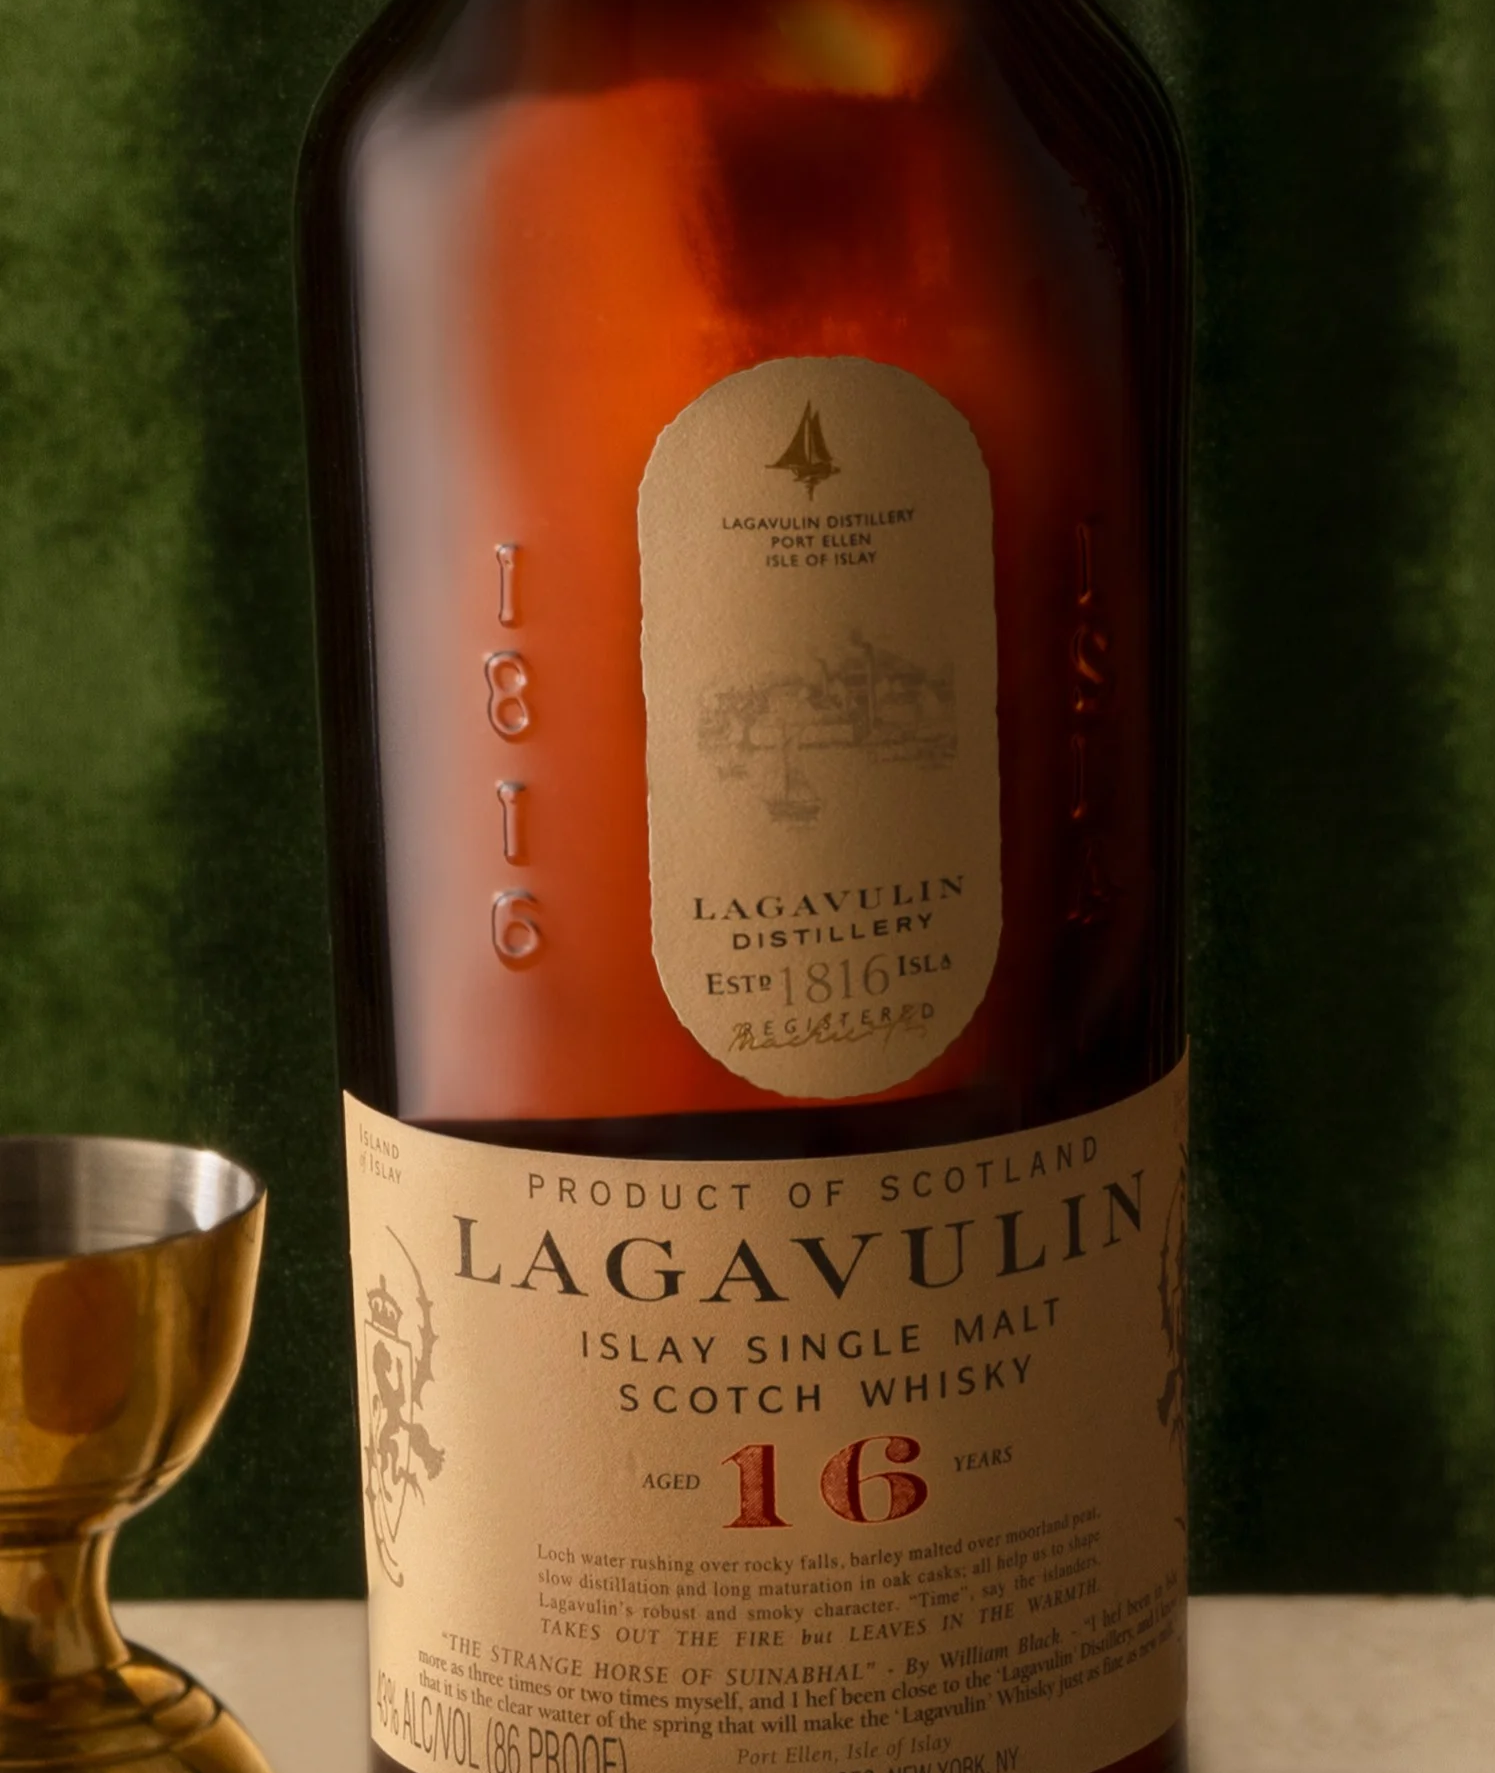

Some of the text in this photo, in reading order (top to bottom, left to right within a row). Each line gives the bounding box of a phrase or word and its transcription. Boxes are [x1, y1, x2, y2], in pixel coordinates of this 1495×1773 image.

[722, 508, 916, 530] LAGAVULIN DISTILLERY
[771, 533, 872, 549] PORT ELLEN
[766, 551, 877, 568] ISLE OF ISLAY
[693, 875, 965, 920] LAGAVULIN
[733, 912, 933, 950] DISTILLERY
[781, 953, 890, 1006] 1816
[529, 1136, 1098, 1211] PRODUCT OF SCOTLAND
[453, 1169, 1145, 1303] LAGAVULIN
[582, 1297, 1060, 1364] ISLAY SINGLE MALT
[620, 1354, 1032, 1414] SCOTCH WHISKY
[641, 1435, 1014, 1529] AGED 16 YEARS
[537, 1543, 576, 1564] Loch
[581, 1551, 625, 1568] water
[630, 1554, 694, 1576] rushing
[700, 1559, 739, 1573] over
[744, 1556, 794, 1578] rocky
[850, 1548, 903, 1569] barley
[908, 1537, 963, 1562] malted
[967, 1533, 1000, 1552] over
[1005, 1516, 1070, 1544] moorland
[538, 1529, 1101, 1600] slow distillation and long maturation in oak casks; all help us to shape
[539, 1592, 633, 1618] Lagavulin’s
[642, 1605, 696, 1621] robust
[706, 1605, 737, 1621] and
[747, 1605, 804, 1624] smoky
[814, 1598, 900, 1618] character.
[981, 1581, 1005, 1601] say
[1014, 1572, 1036, 1591] the
[540, 1618, 601, 1640] TAKES
[615, 1626, 660, 1645] OUT
[677, 1630, 719, 1648] THE
[735, 1630, 785, 1647] FIRE
[801, 1628, 833, 1645] but
[850, 1617, 927, 1642] LEAVES
[942, 1613, 964, 1631] IN
[979, 1602, 1015, 1625] THE
[418, 1650, 448, 1672] more
[451, 1662, 464, 1677] as
[468, 1662, 504, 1688] three
[508, 1672, 552, 1696] times
[556, 1684, 576, 1700] or
[580, 1686, 613, 1705] two
[618, 1688, 669, 1708] times
[675, 1691, 744, 1714] myself,
[749, 1691, 785, 1711] and
[791, 1691, 799, 1709] I
[805, 1688, 836, 1708] hef
[841, 1686, 886, 1706] been
[891, 1680, 938, 1701] close
[943, 1678, 959, 1694] to
[965, 1669, 991, 1690] the
[490, 1645, 583, 1678] STRANGE
[594, 1661, 669, 1685] HORSE
[682, 1667, 714, 1686] OF
[906, 1657, 930, 1680] By
[940, 1643, 1009, 1668] William
[420, 1669, 441, 1693] that
[443, 1679, 453, 1697] it
[456, 1683, 467, 1702] is
[471, 1687, 493, 1709] the
[497, 1696, 533, 1719] clear
[537, 1707, 591, 1726] watter
[596, 1710, 615, 1728] of
[618, 1712, 647, 1731] the
[652, 1716, 713, 1739] spring
[718, 1716, 755, 1734] that
[761, 1714, 797, 1733] will
[803, 1712, 854, 1731] make
[860, 1709, 889, 1728] the
[996, 1679, 1054, 1707] Whisky
[1057, 1670, 1083, 1697] just
[1086, 1666, 1101, 1682] as
[737, 1733, 952, 1765] Port Ellen, Isle of Islay
[996, 1746, 1020, 1773] NY
